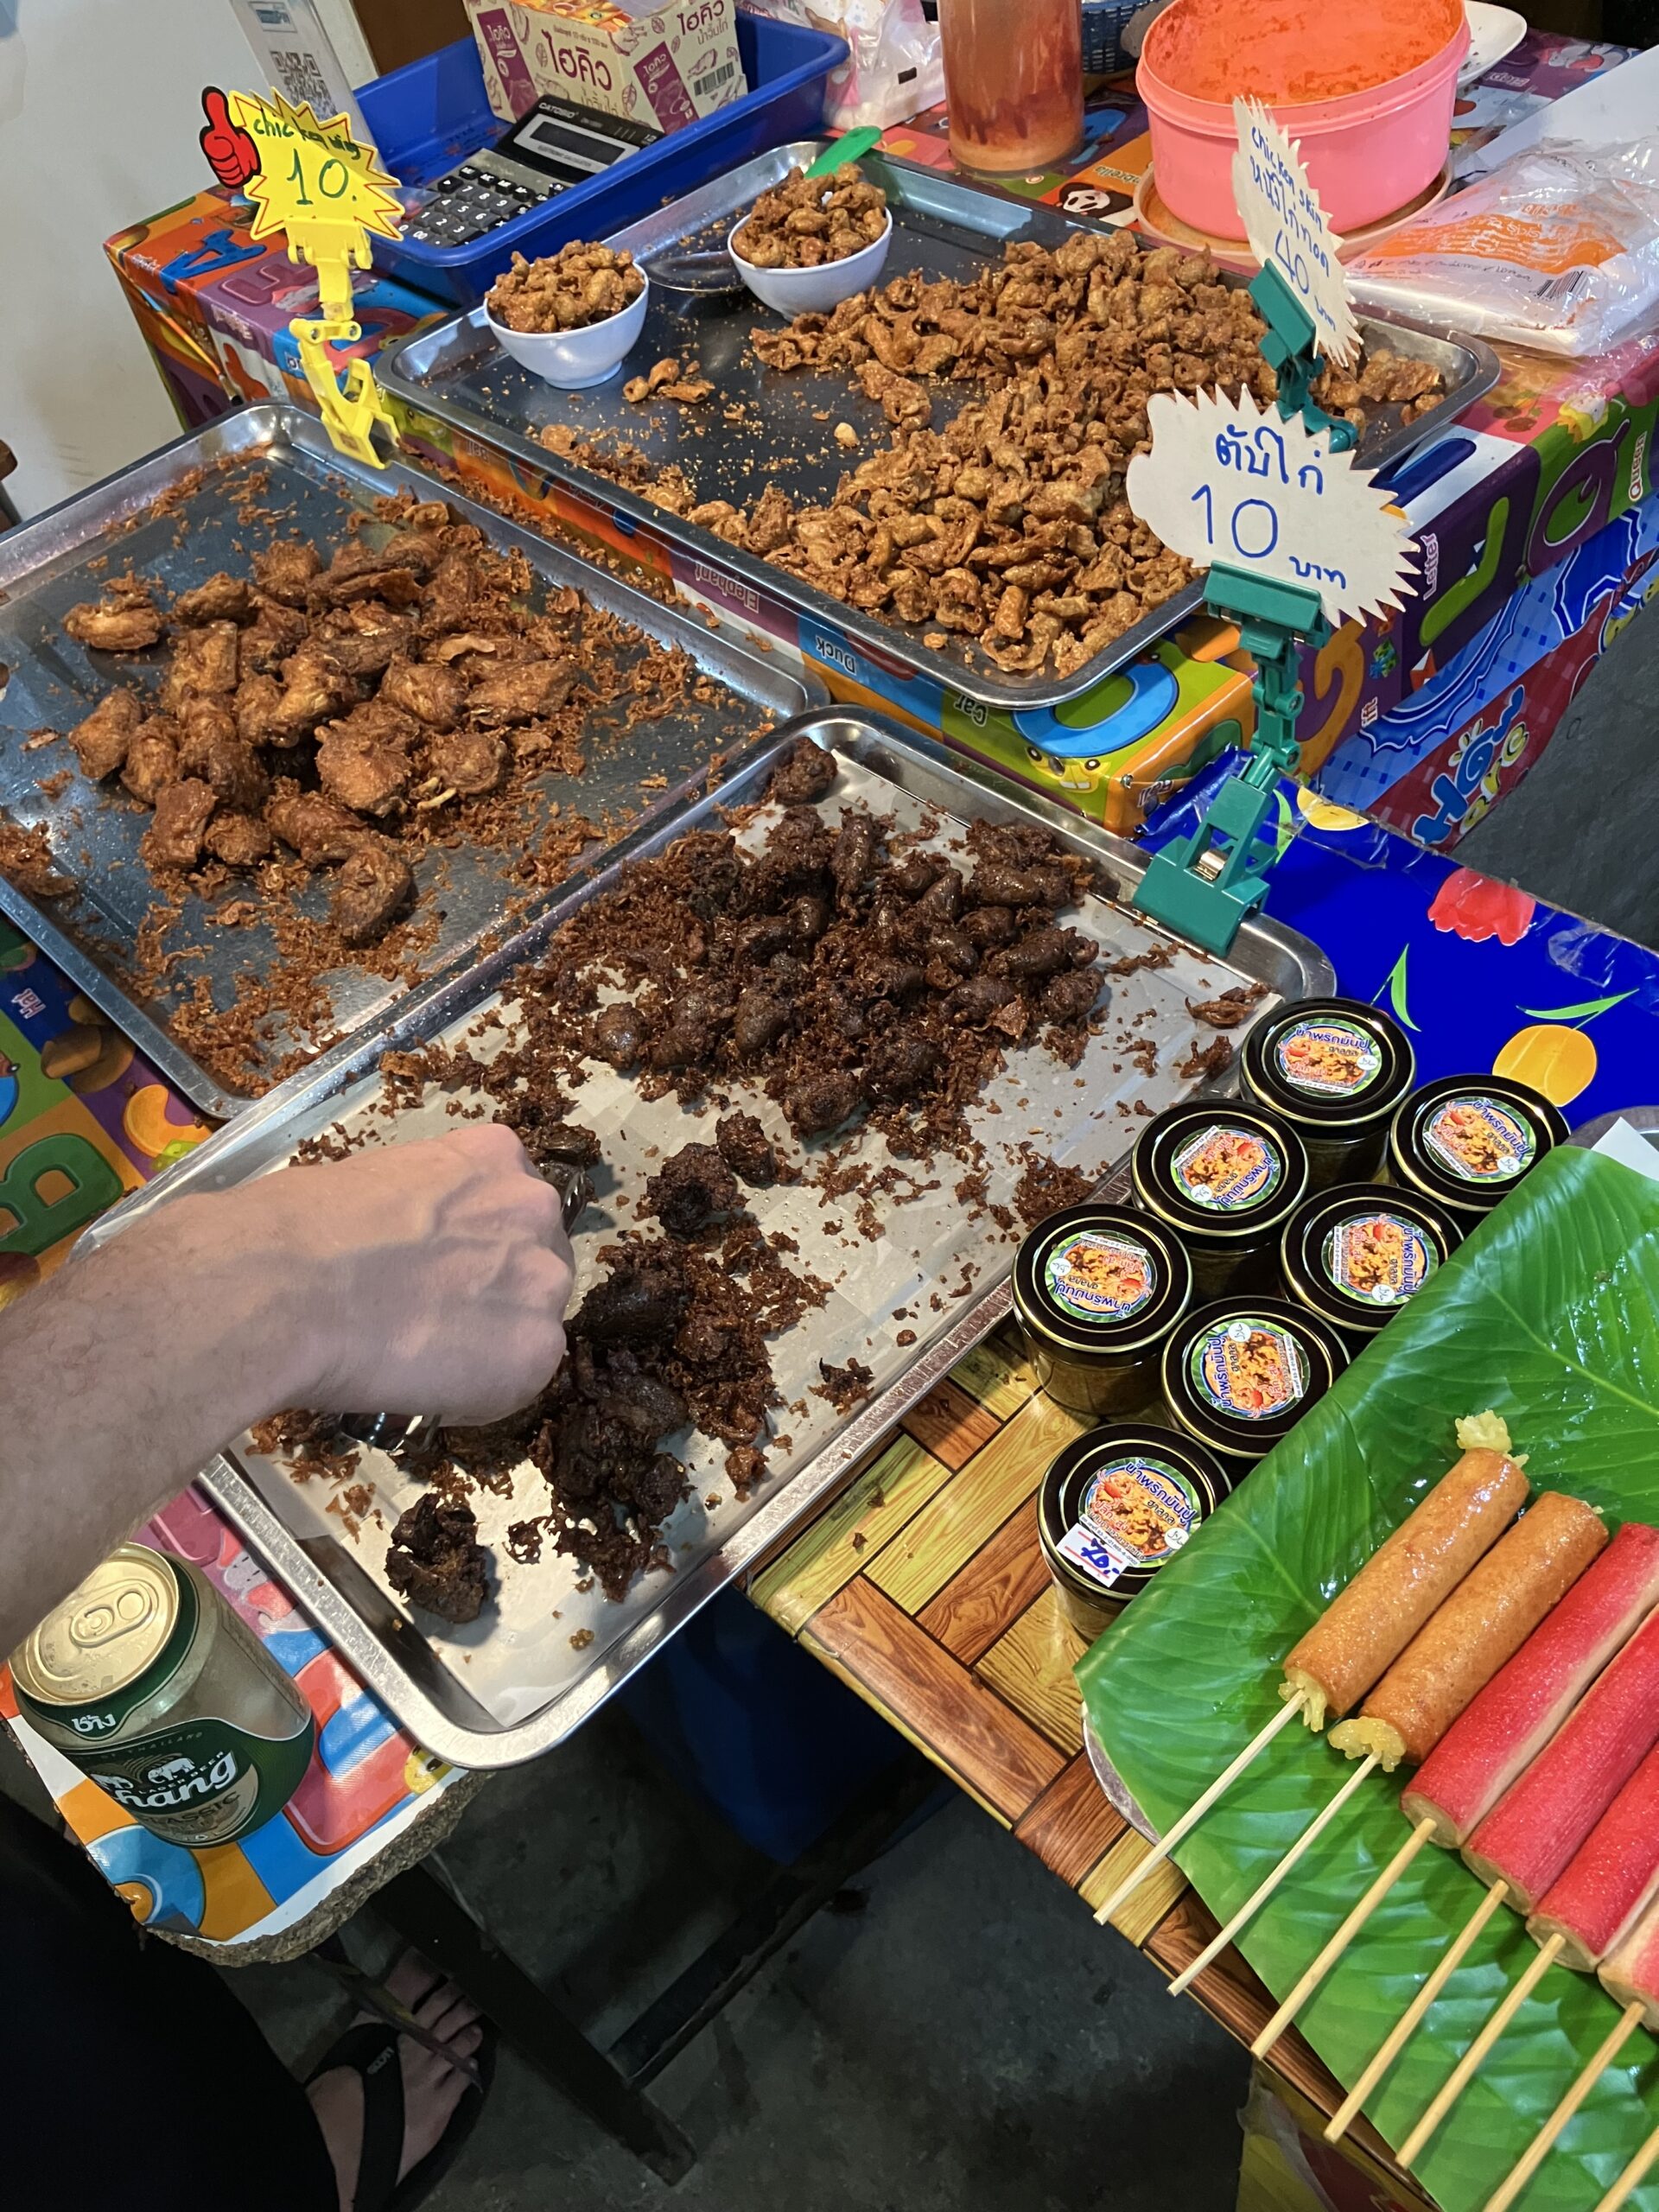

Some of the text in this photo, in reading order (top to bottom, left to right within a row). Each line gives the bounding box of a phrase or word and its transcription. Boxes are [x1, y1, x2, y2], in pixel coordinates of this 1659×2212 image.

[677, 0, 725, 35] ไฮคิว
[541, 29, 613, 92] ไฮคิว
[457, 205, 469, 213] 5
[1251, 126, 1323, 233] chicken skin
[435, 218, 448, 226] 2
[1274, 229, 1310, 295] 40
[1216, 423, 1324, 495] ตับไก่
[1628, 430, 1648, 502] Queen
[1191, 484, 1279, 558] 10
[695, 561, 760, 614] Elephant
[1288, 556, 1347, 589] บาท
[1421, 531, 1440, 601] Letter
[816, 635, 858, 677] Duck
[954, 694, 988, 728] Car
[1411, 684, 1525, 845] How
[10, 988, 46, 1020] Hat
[1205, 1336, 1234, 1410] น้ำพริกมันปู
[1123, 1458, 1198, 1527] น้ำพริกมันปู
[71, 1713, 117, 1733] ช้าง
[114, 1749, 238, 1808] hang
[189, 1751, 225, 1778] BEER
